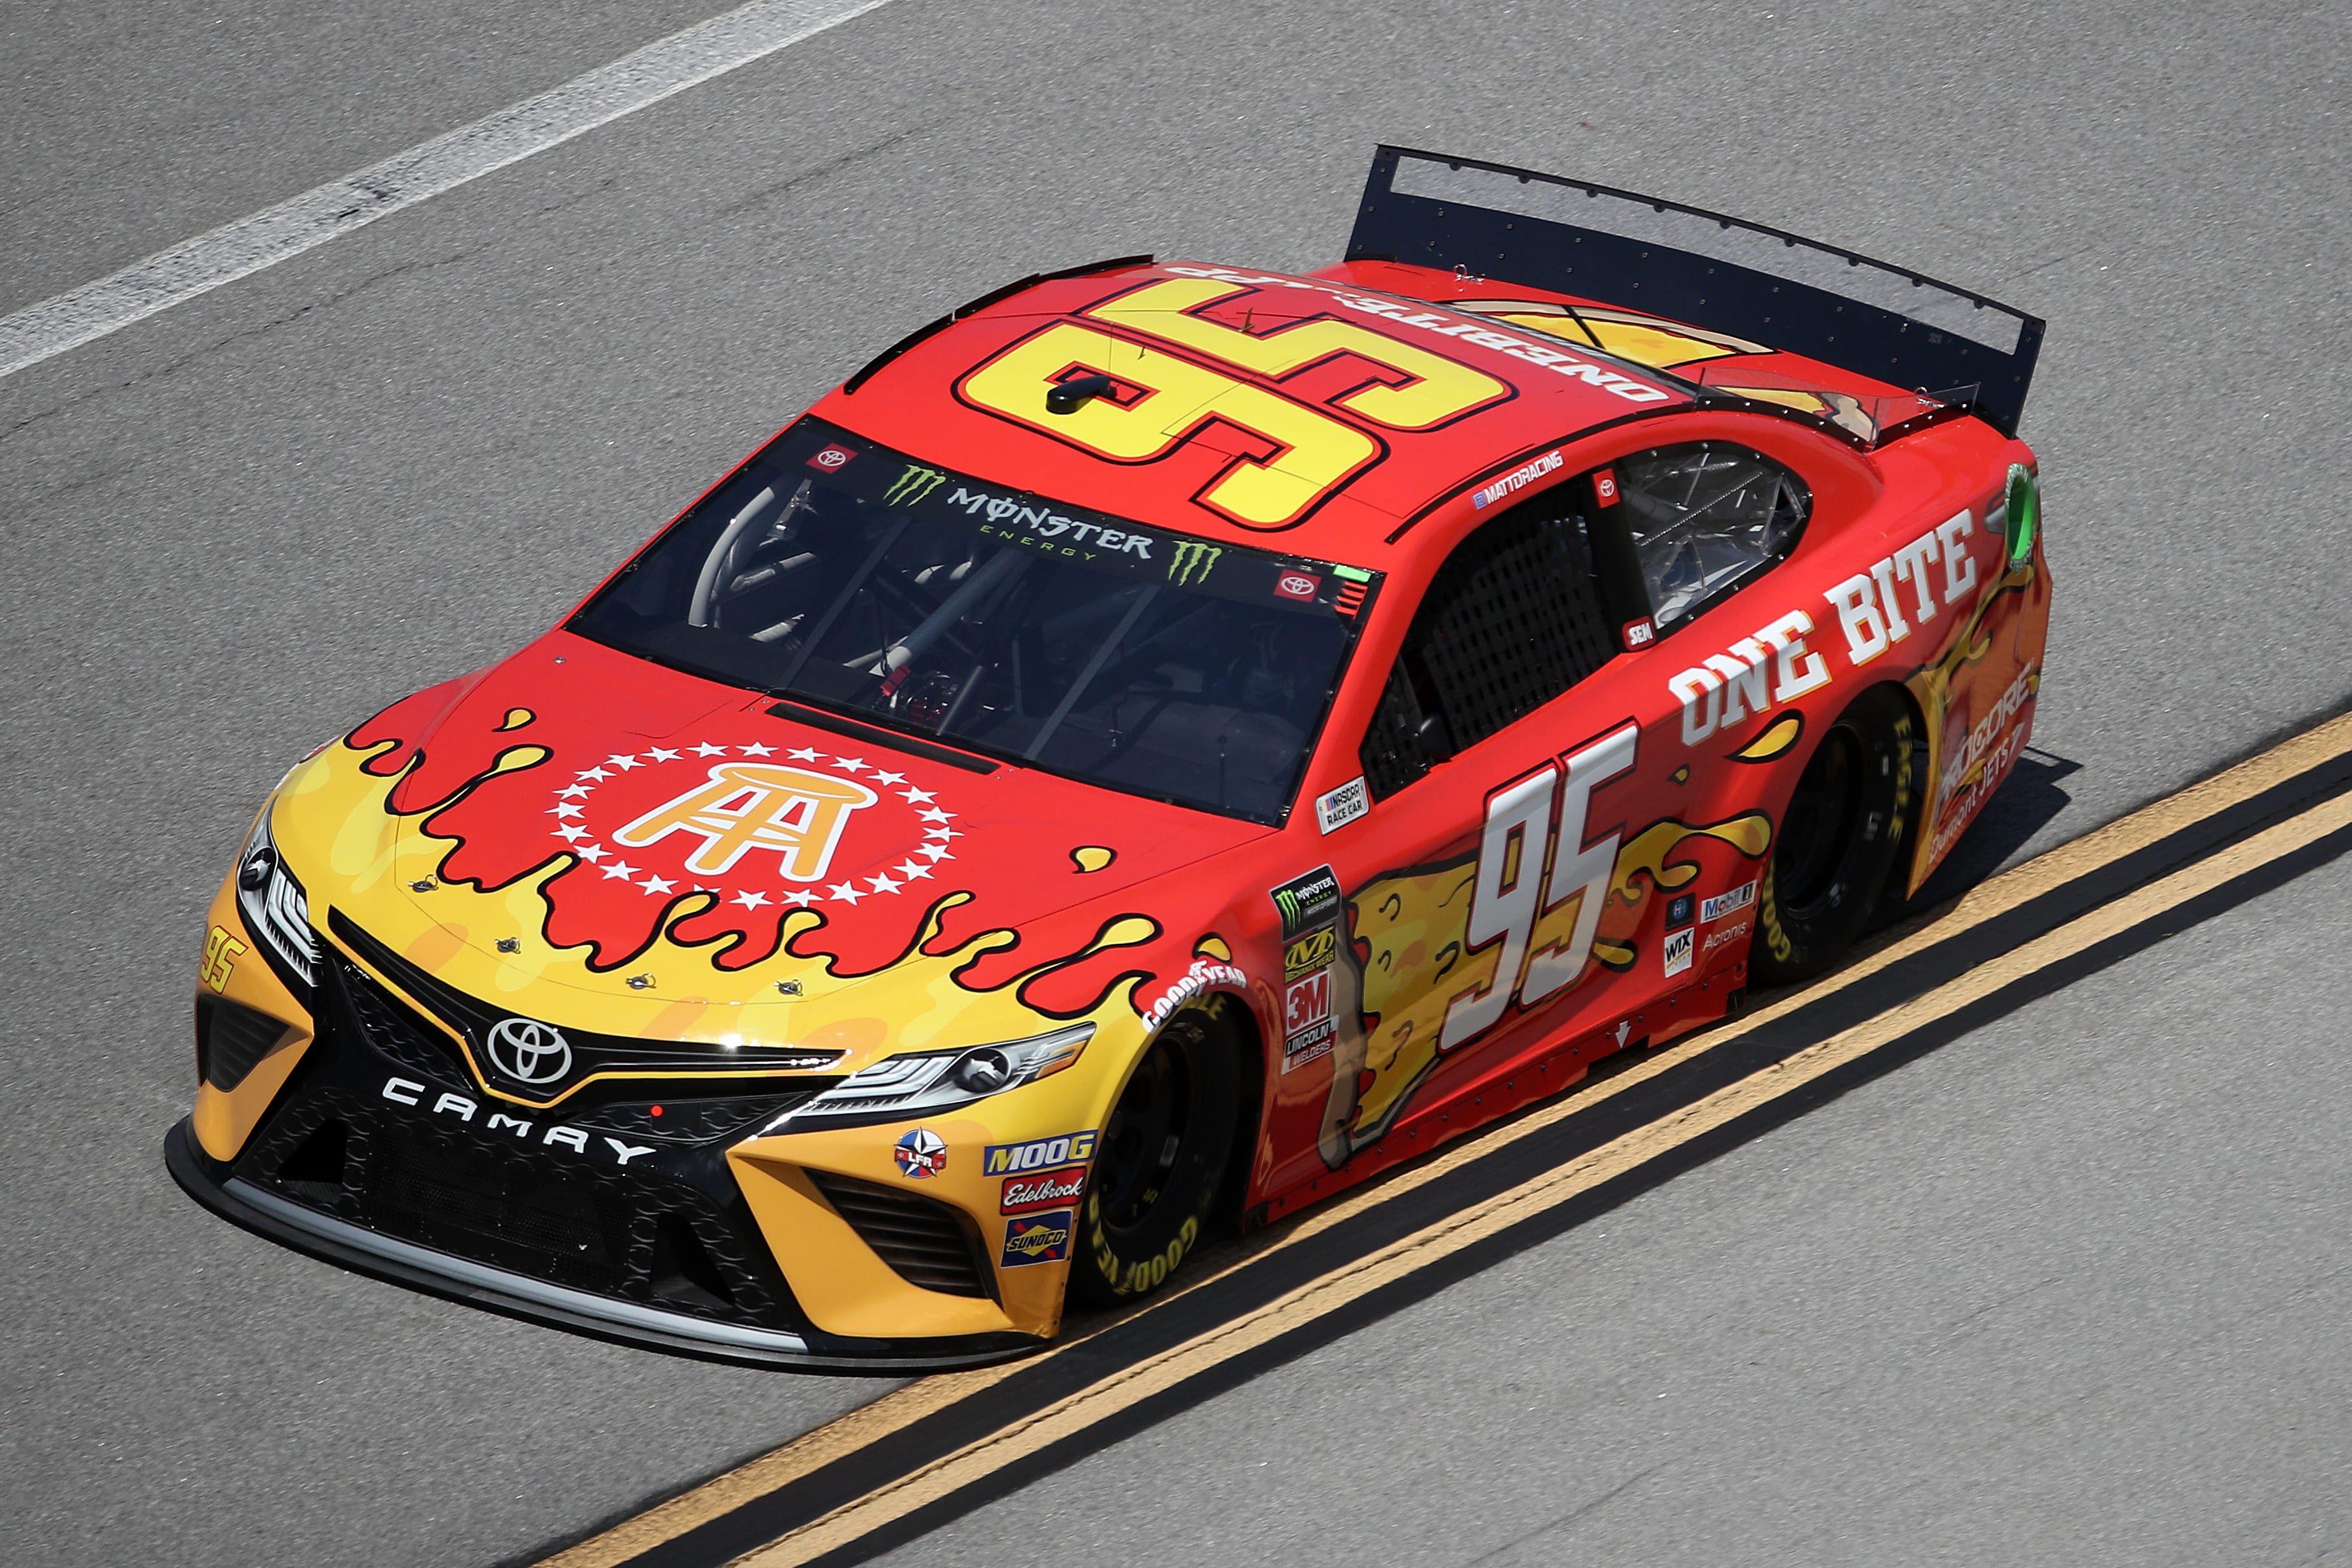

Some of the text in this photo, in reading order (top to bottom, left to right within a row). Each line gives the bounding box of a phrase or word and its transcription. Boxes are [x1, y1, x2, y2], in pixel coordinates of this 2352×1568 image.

[961, 275, 1509, 526] 95
[947, 486, 1153, 560] MONSTER
[979, 524, 1097, 562] ENERGY
[1629, 622, 1653, 646] SEM
[1669, 509, 1976, 748] ONE BITE
[1979, 737, 2010, 797] JETS
[1333, 783, 1361, 808] NASCAR
[1326, 800, 1363, 826] RACE CAR
[1295, 876, 1335, 901] MONSTER
[1305, 891, 1332, 906] ENERGY
[1439, 720, 1640, 1052] 95
[1704, 887, 1741, 918] Mobil
[1666, 929, 1694, 962] WIX
[1702, 921, 1747, 952] Acronis
[201, 926, 249, 994] 95
[1316, 950, 1335, 969] WEAR
[1142, 959, 1247, 1034] GOODYEAR
[1288, 973, 1329, 1030] 3M
[1286, 1024, 1330, 1056] LINCOLN
[1293, 1039, 1332, 1066] WELDERS
[382, 1077, 657, 1165] CAMRY
[908, 1151, 933, 1168] LFR
[989, 1134, 1095, 1173] MOOG
[1002, 1175, 1084, 1207] Edelbrock
[1005, 1227, 1068, 1252] SUNOCO
